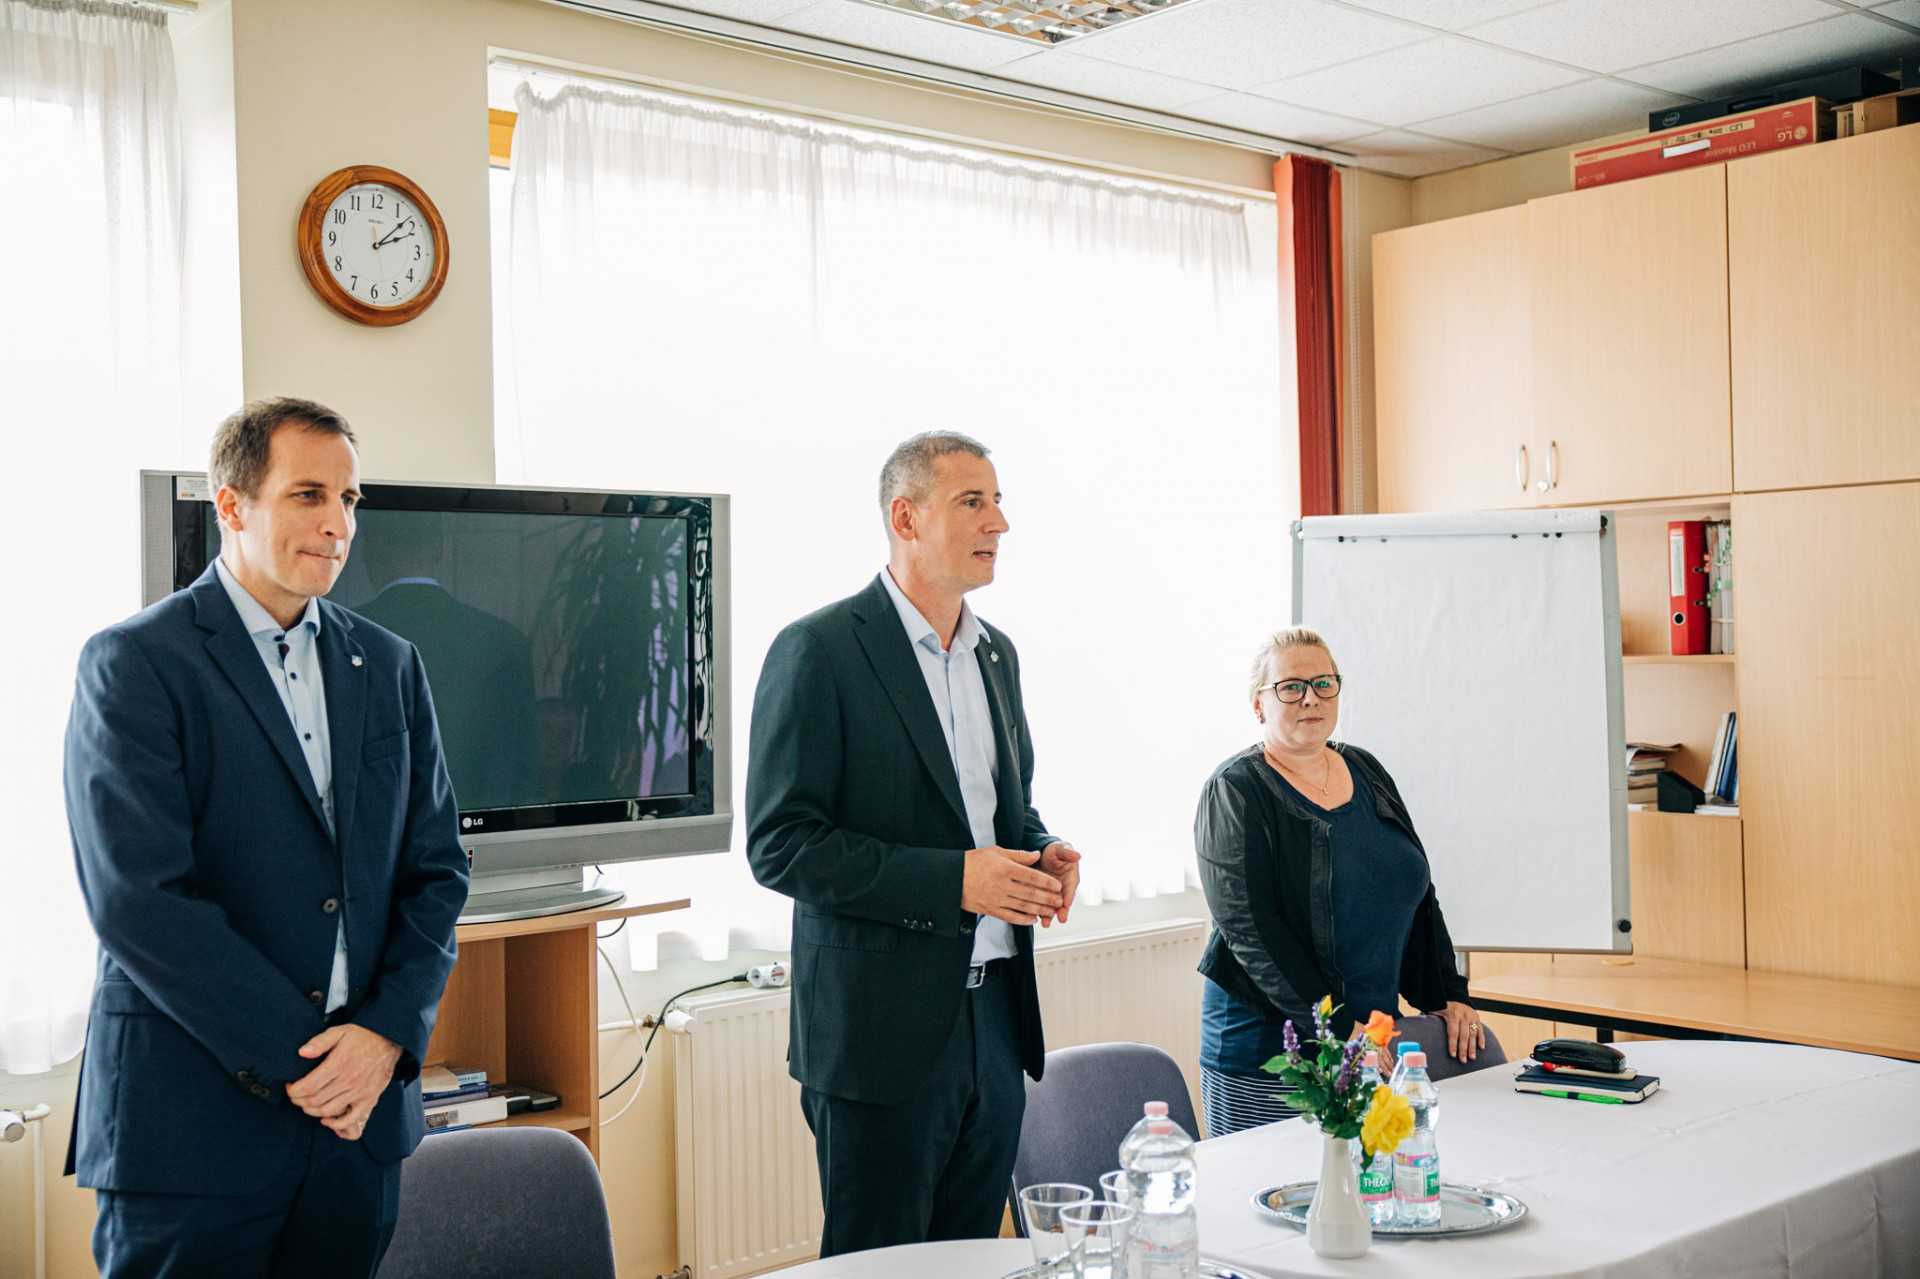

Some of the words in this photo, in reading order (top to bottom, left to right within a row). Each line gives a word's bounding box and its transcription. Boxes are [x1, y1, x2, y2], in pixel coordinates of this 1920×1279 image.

[1777, 130, 1793, 143] LG
[1738, 141, 1757, 153] LED
[351, 194, 361, 211] 11
[371, 193, 384, 210] 12
[334, 208, 346, 224] 10
[395, 202, 400, 218] 1
[408, 220, 416, 236] 2
[328, 230, 337, 246] 9
[413, 244, 421, 261] 3
[334, 255, 342, 271] 8
[351, 275, 358, 291] 7
[405, 268, 414, 282] 4
[370, 283, 379, 299] 6
[391, 281, 399, 297] 5
